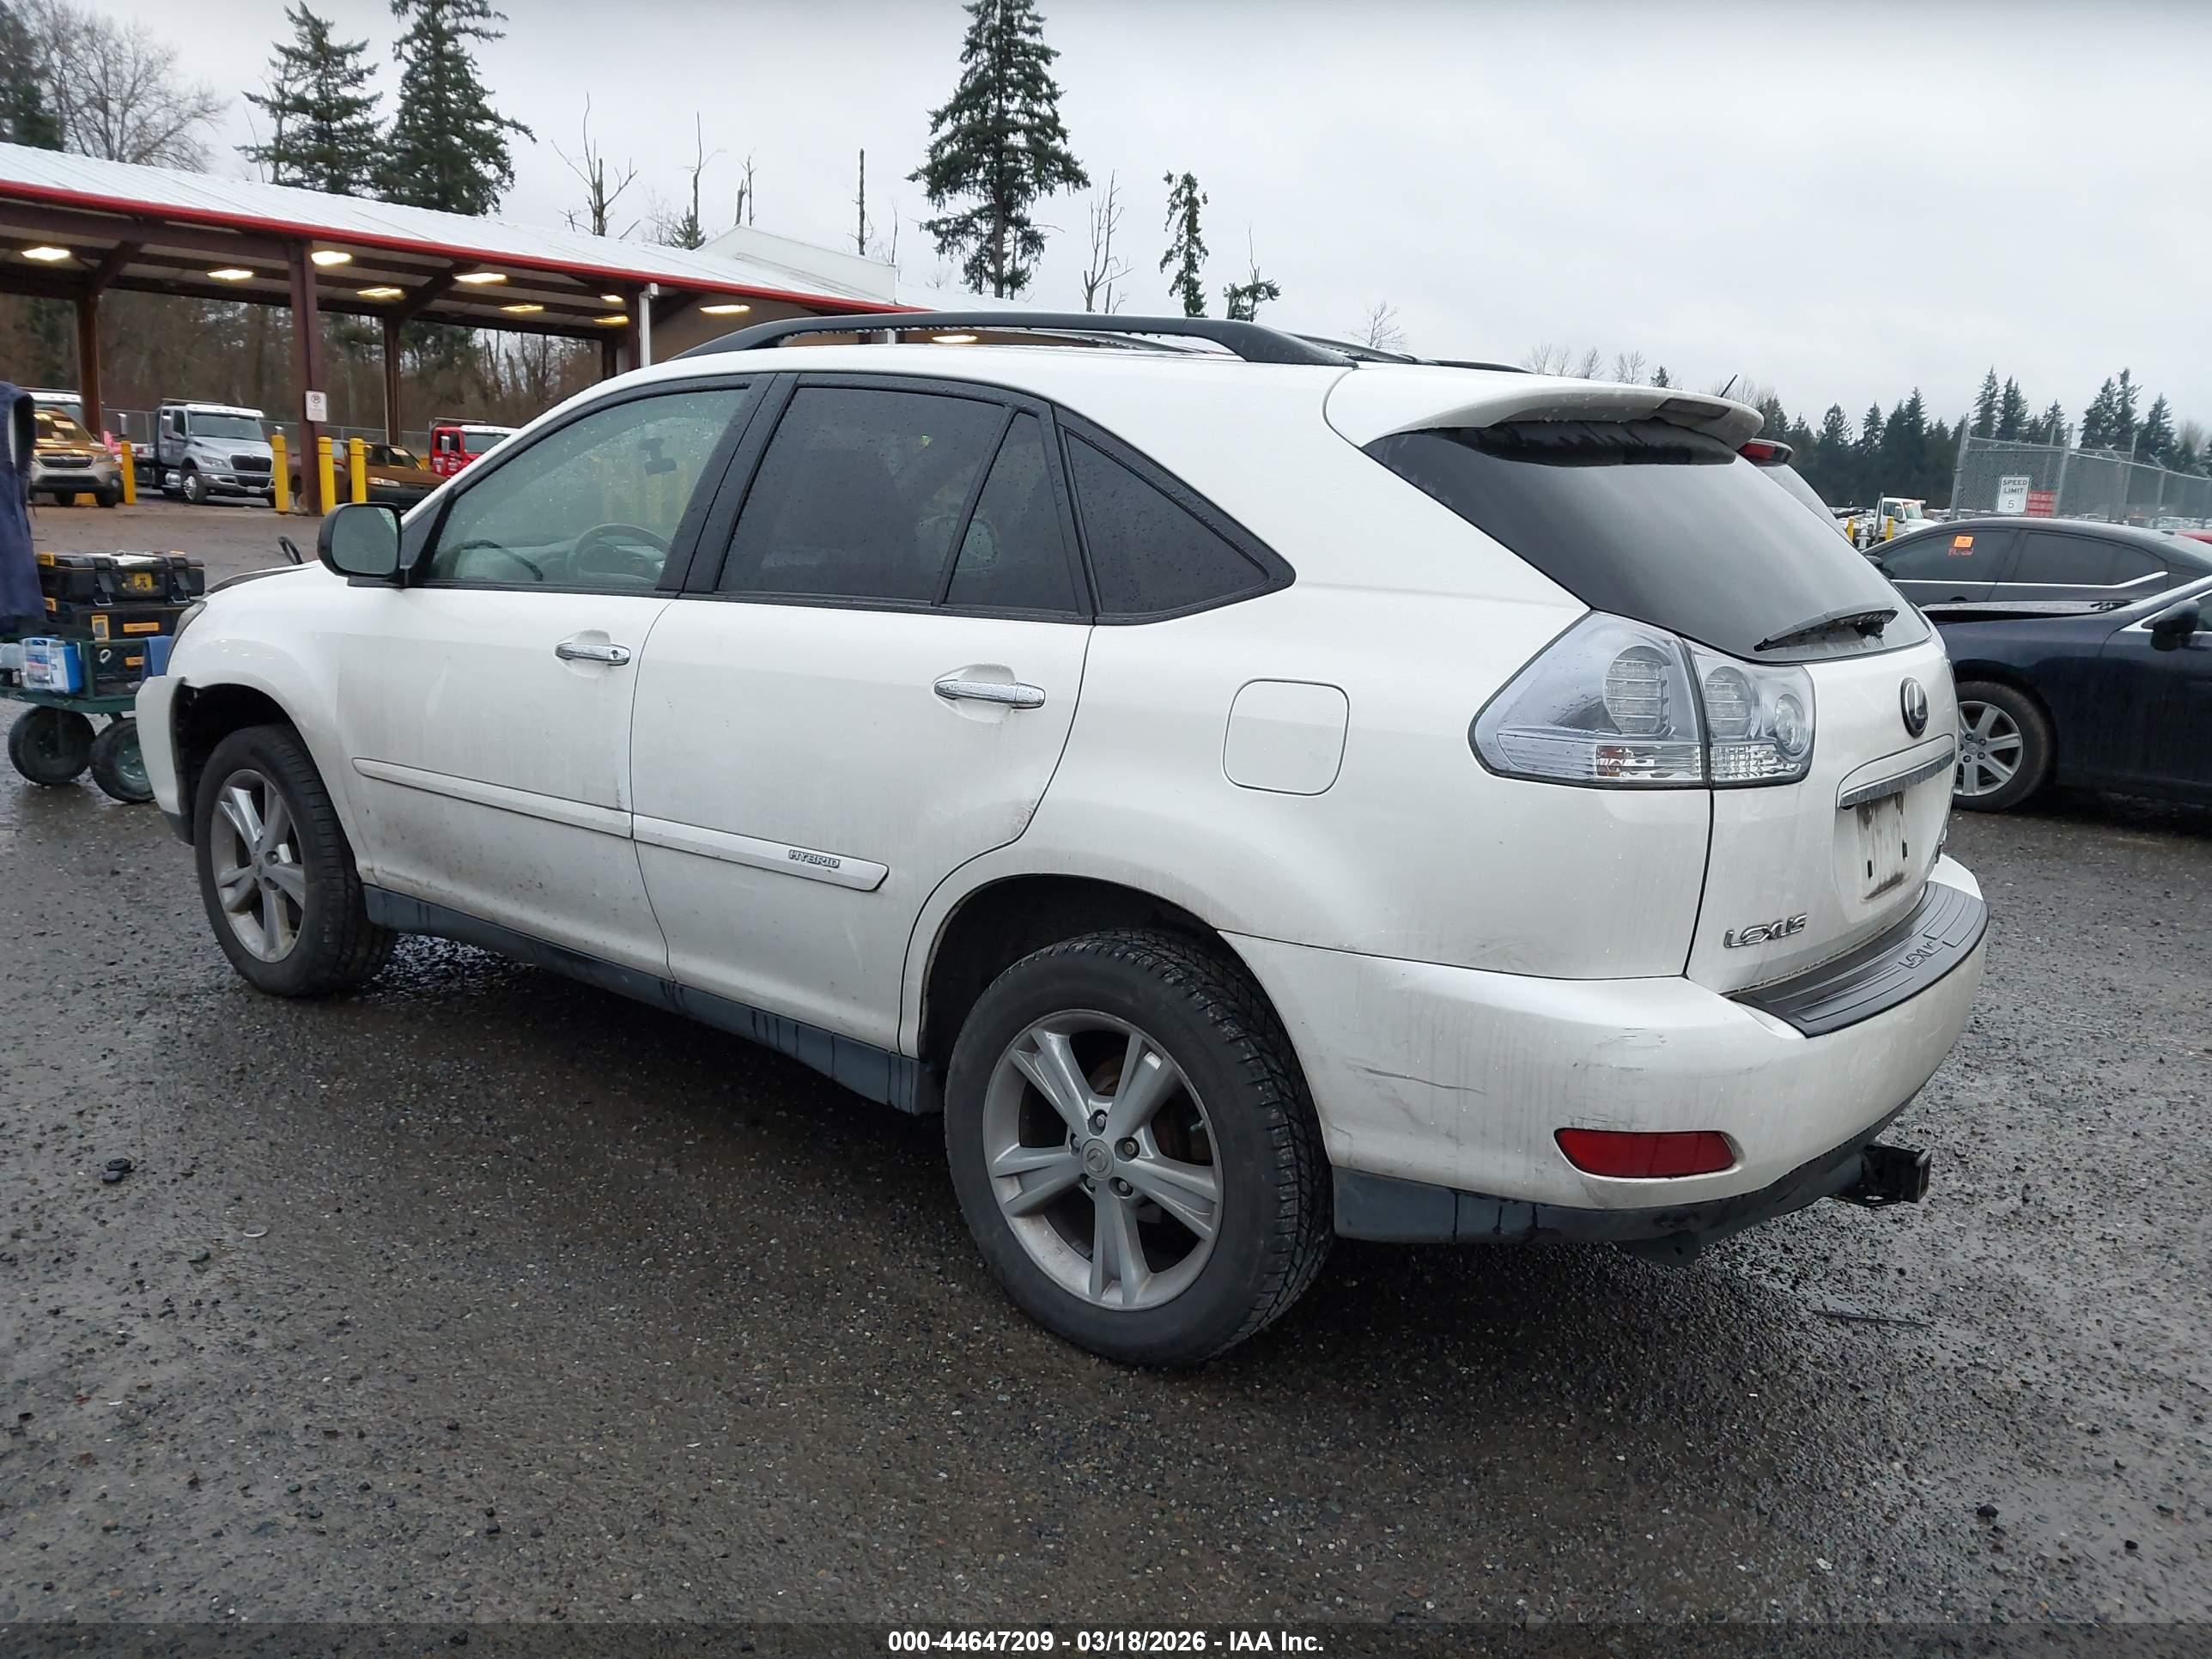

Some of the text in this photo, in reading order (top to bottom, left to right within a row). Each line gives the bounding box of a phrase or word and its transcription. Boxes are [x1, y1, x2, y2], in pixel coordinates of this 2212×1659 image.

[2007, 500, 2014, 508] 5
[788, 849, 841, 868] HYBRID
[1723, 913, 1808, 948] LEXUS
